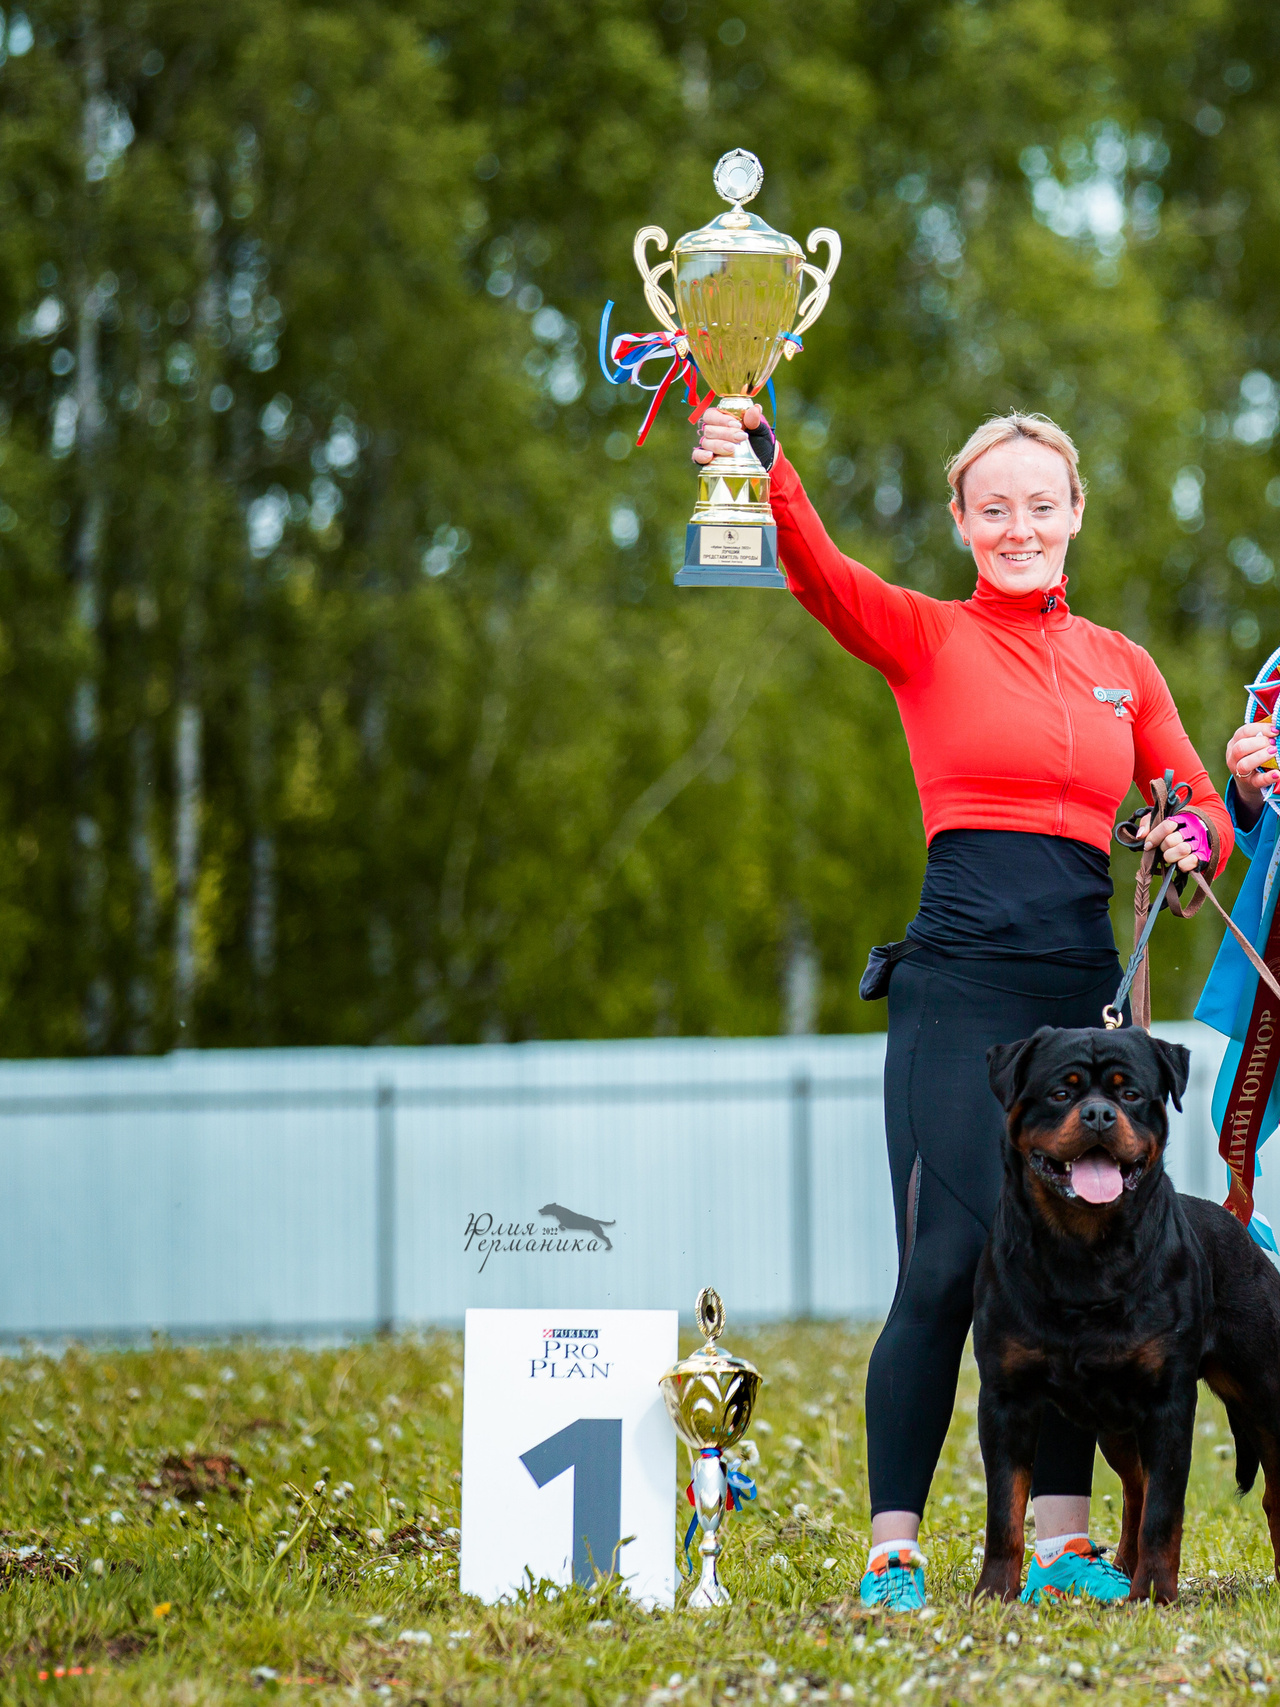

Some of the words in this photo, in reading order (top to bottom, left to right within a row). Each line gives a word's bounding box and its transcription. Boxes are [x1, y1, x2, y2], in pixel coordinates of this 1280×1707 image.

[1239, 1009, 1278, 1103] ЮНИОР
[553, 1329, 598, 1338] PURINA
[519, 1418, 623, 1594] 1
